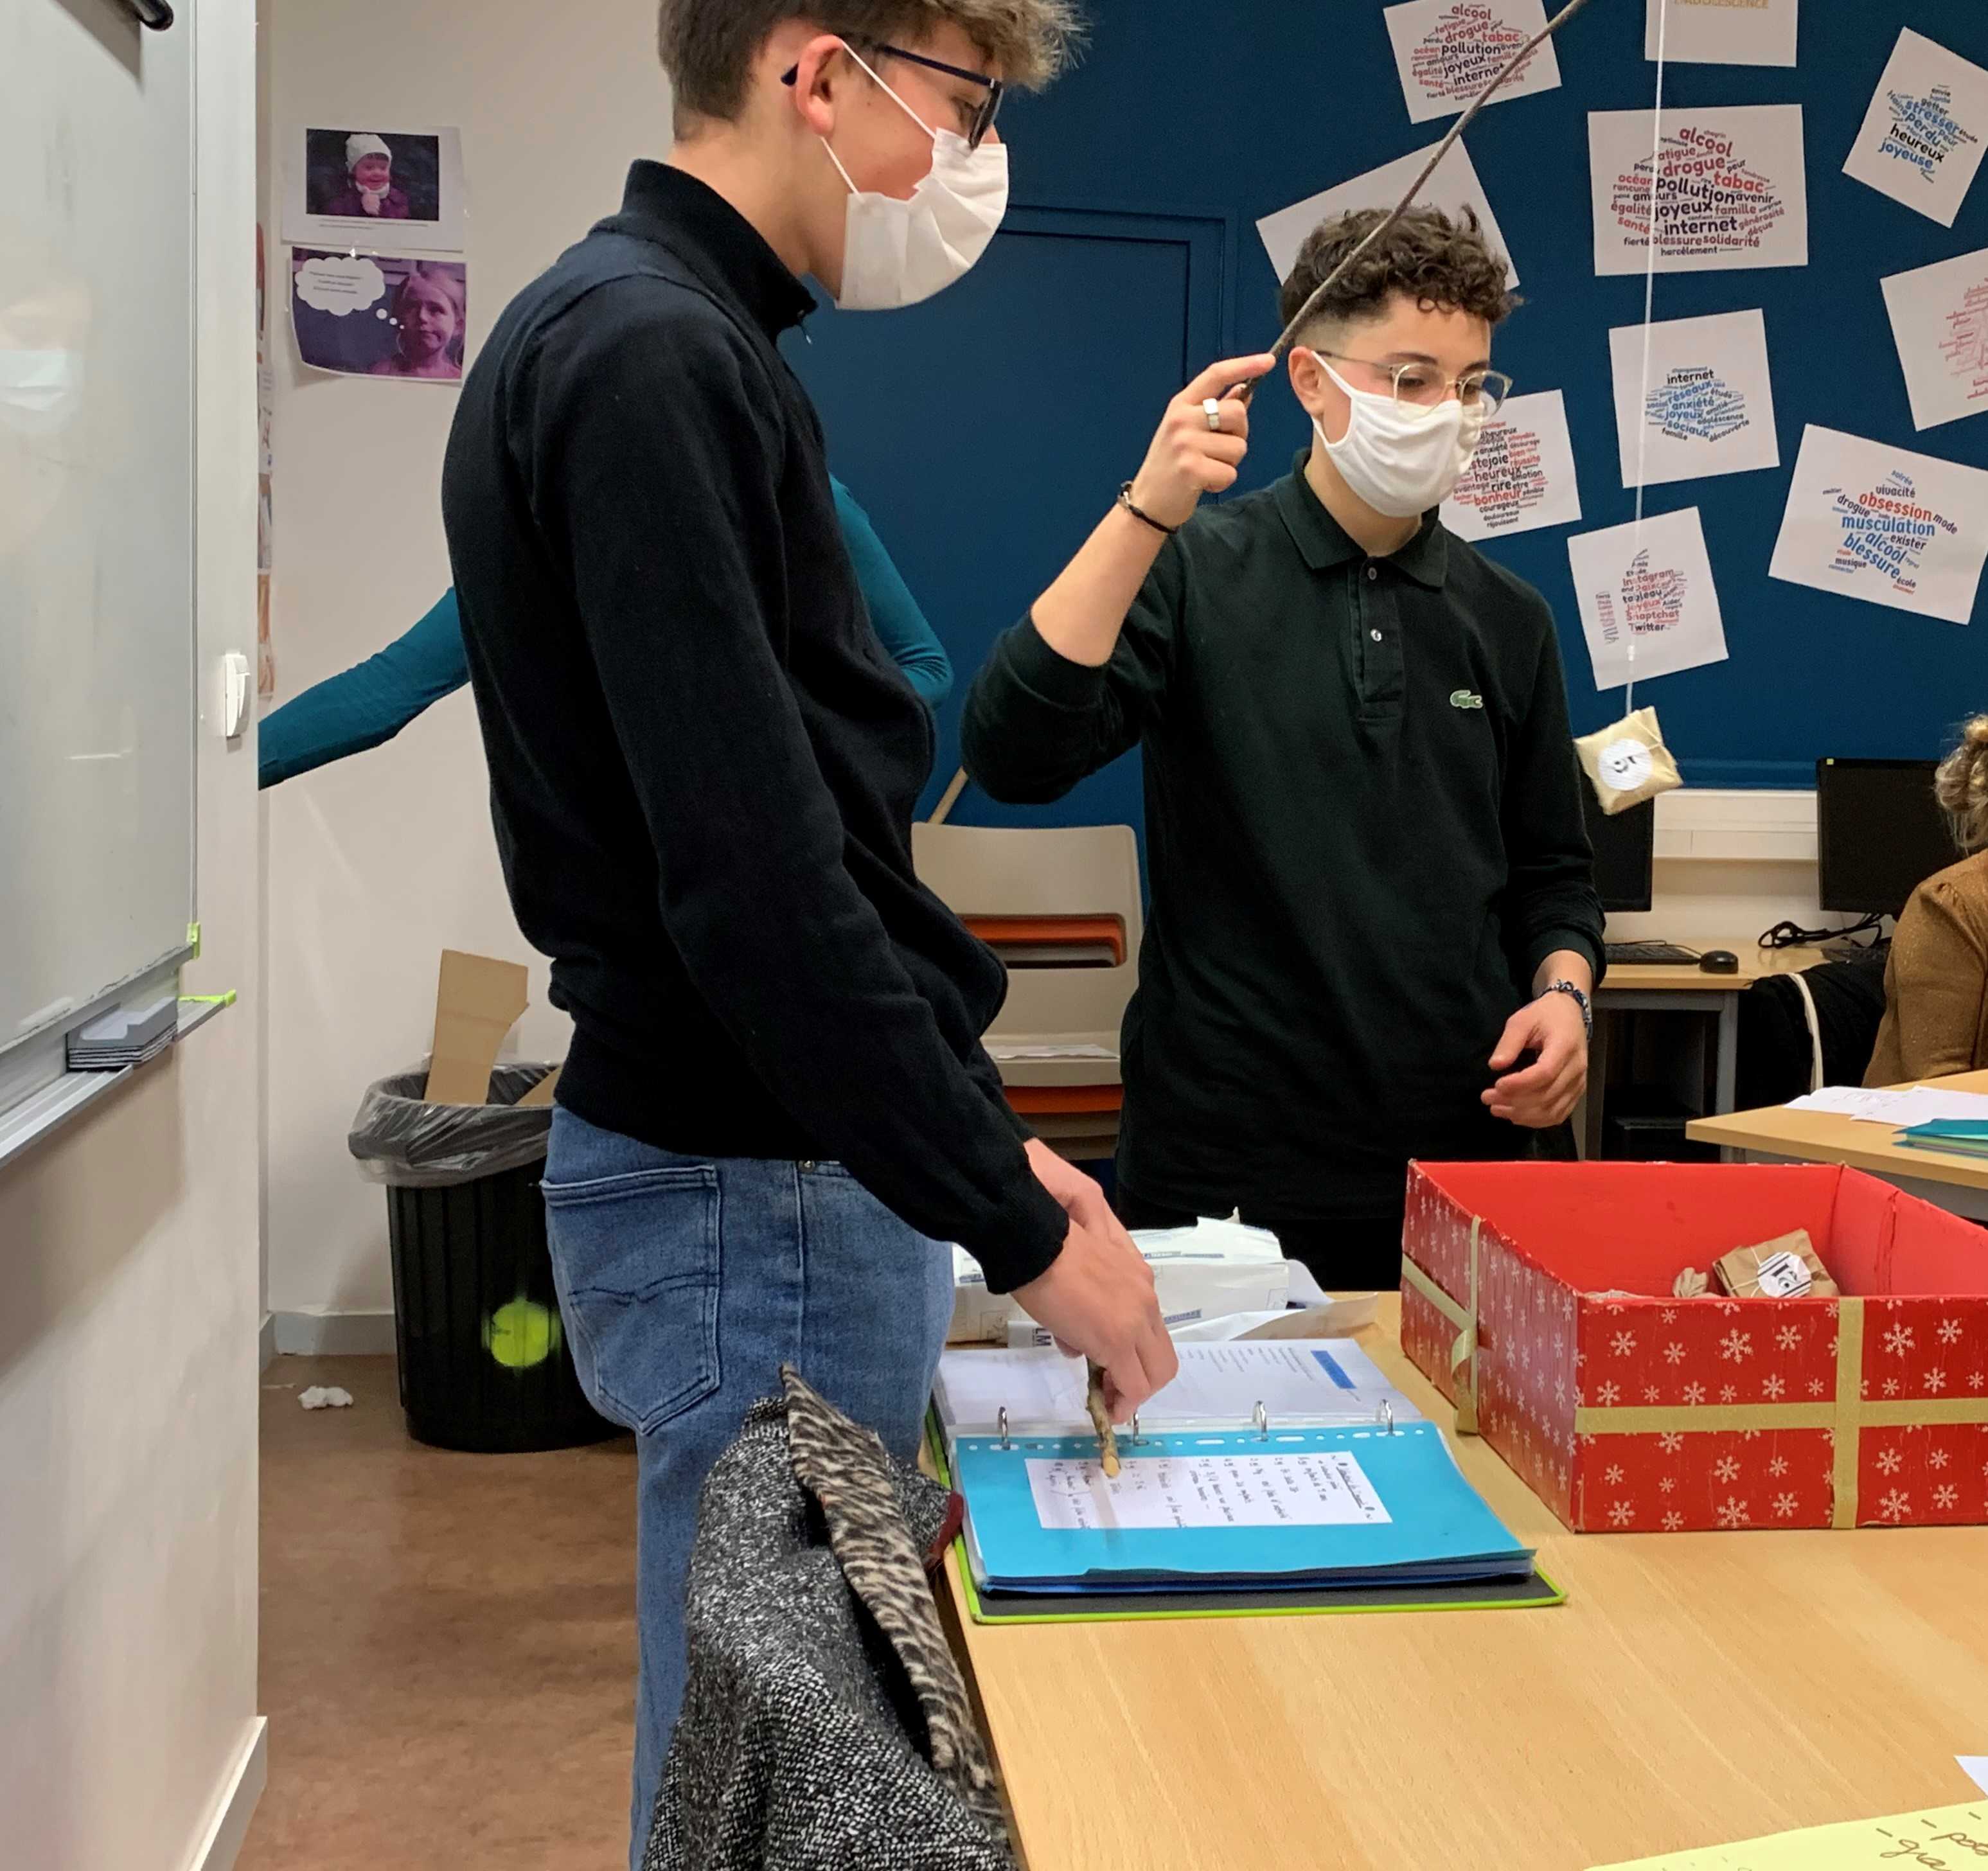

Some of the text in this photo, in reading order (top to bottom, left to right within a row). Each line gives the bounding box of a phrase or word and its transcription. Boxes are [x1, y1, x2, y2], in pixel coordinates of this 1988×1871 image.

[1451, 3, 1491, 20] alcool
[1445, 21, 1488, 44] drogue
[1482, 31, 1519, 42] tabac
[1442, 42, 1501, 57] pollution
[1444, 56, 1486, 78] joyeux
[1905, 100, 1960, 134] stresser
[1680, 127, 1733, 157] alcool
[1890, 123, 1944, 163] heureux
[1658, 147, 1696, 161] atigue
[1878, 137, 1933, 169] joyeuse
[1634, 163, 1660, 174] perd
[1663, 157, 1725, 177] drogue
[1714, 170, 1764, 193] tabac
[1633, 192, 1677, 201] amurs
[1656, 177, 1735, 206] pollution
[1736, 192, 1774, 204] avenir
[1655, 200, 1713, 222] joyeux
[1715, 204, 1757, 215] famille
[1617, 217, 1650, 235] santé
[1664, 216, 1737, 235] internet
[1703, 233, 1760, 247] solidarité
[1667, 369, 1714, 384] internet
[1668, 380, 1712, 403] réseaux
[1672, 396, 1714, 411] anxiété
[1664, 407, 1703, 421] joyeux
[1667, 420, 1710, 438] sociaux
[1474, 467, 1521, 482] heureux
[1492, 479, 1512, 492] rire
[1876, 483, 1916, 499] vivacité
[1474, 490, 1521, 507] bonheur
[1837, 493, 1870, 518] drogue
[1859, 492, 1932, 522] obsession
[1842, 516, 1935, 536] musculation
[1933, 513, 1958, 535] mode
[1865, 532, 1907, 564] alcool
[1890, 534, 1926, 551] exister
[1835, 557, 1867, 569] musique
[1843, 533, 1900, 579] blessure
[1626, 569, 1646, 577] Etde
[1628, 622, 1665, 632] Twitter
